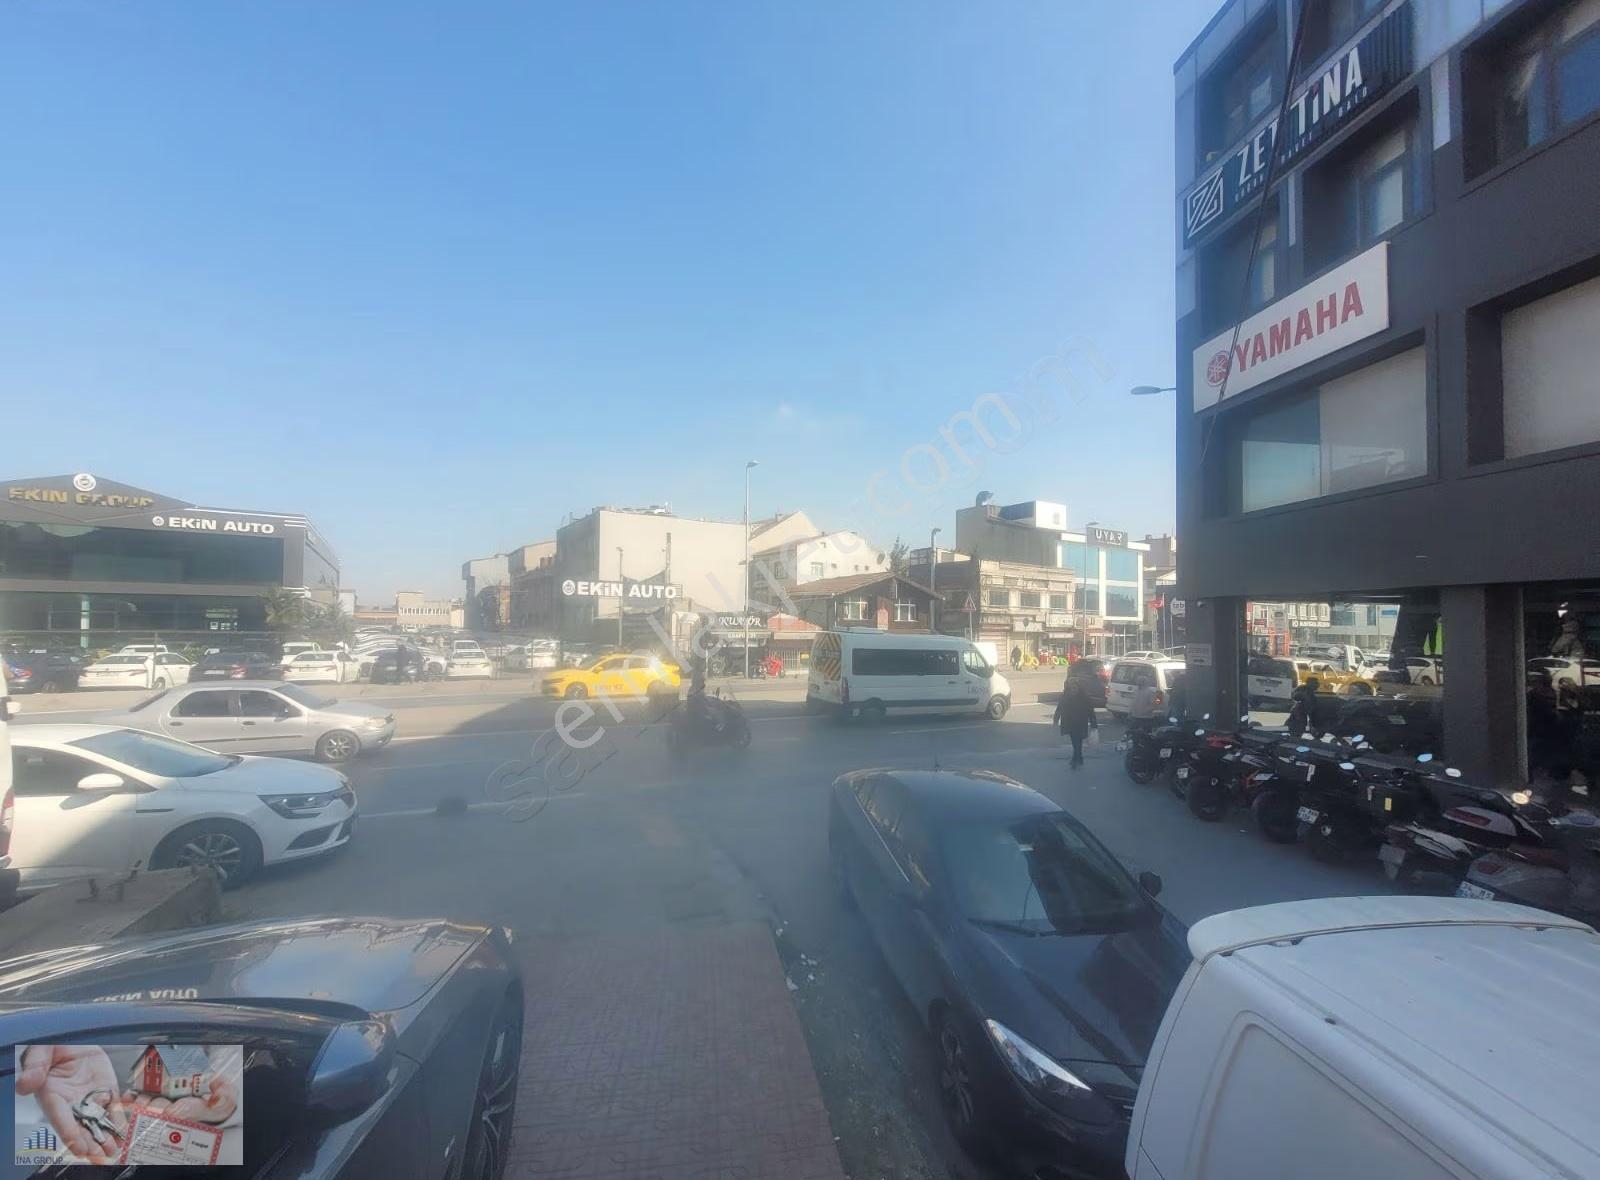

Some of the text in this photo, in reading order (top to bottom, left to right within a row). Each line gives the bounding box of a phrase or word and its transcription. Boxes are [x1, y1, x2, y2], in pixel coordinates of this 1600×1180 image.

[1235, 281, 1364, 373] YAMAHA
[224, 521, 275, 534] AUTO
[629, 584, 677, 599] AUTO
